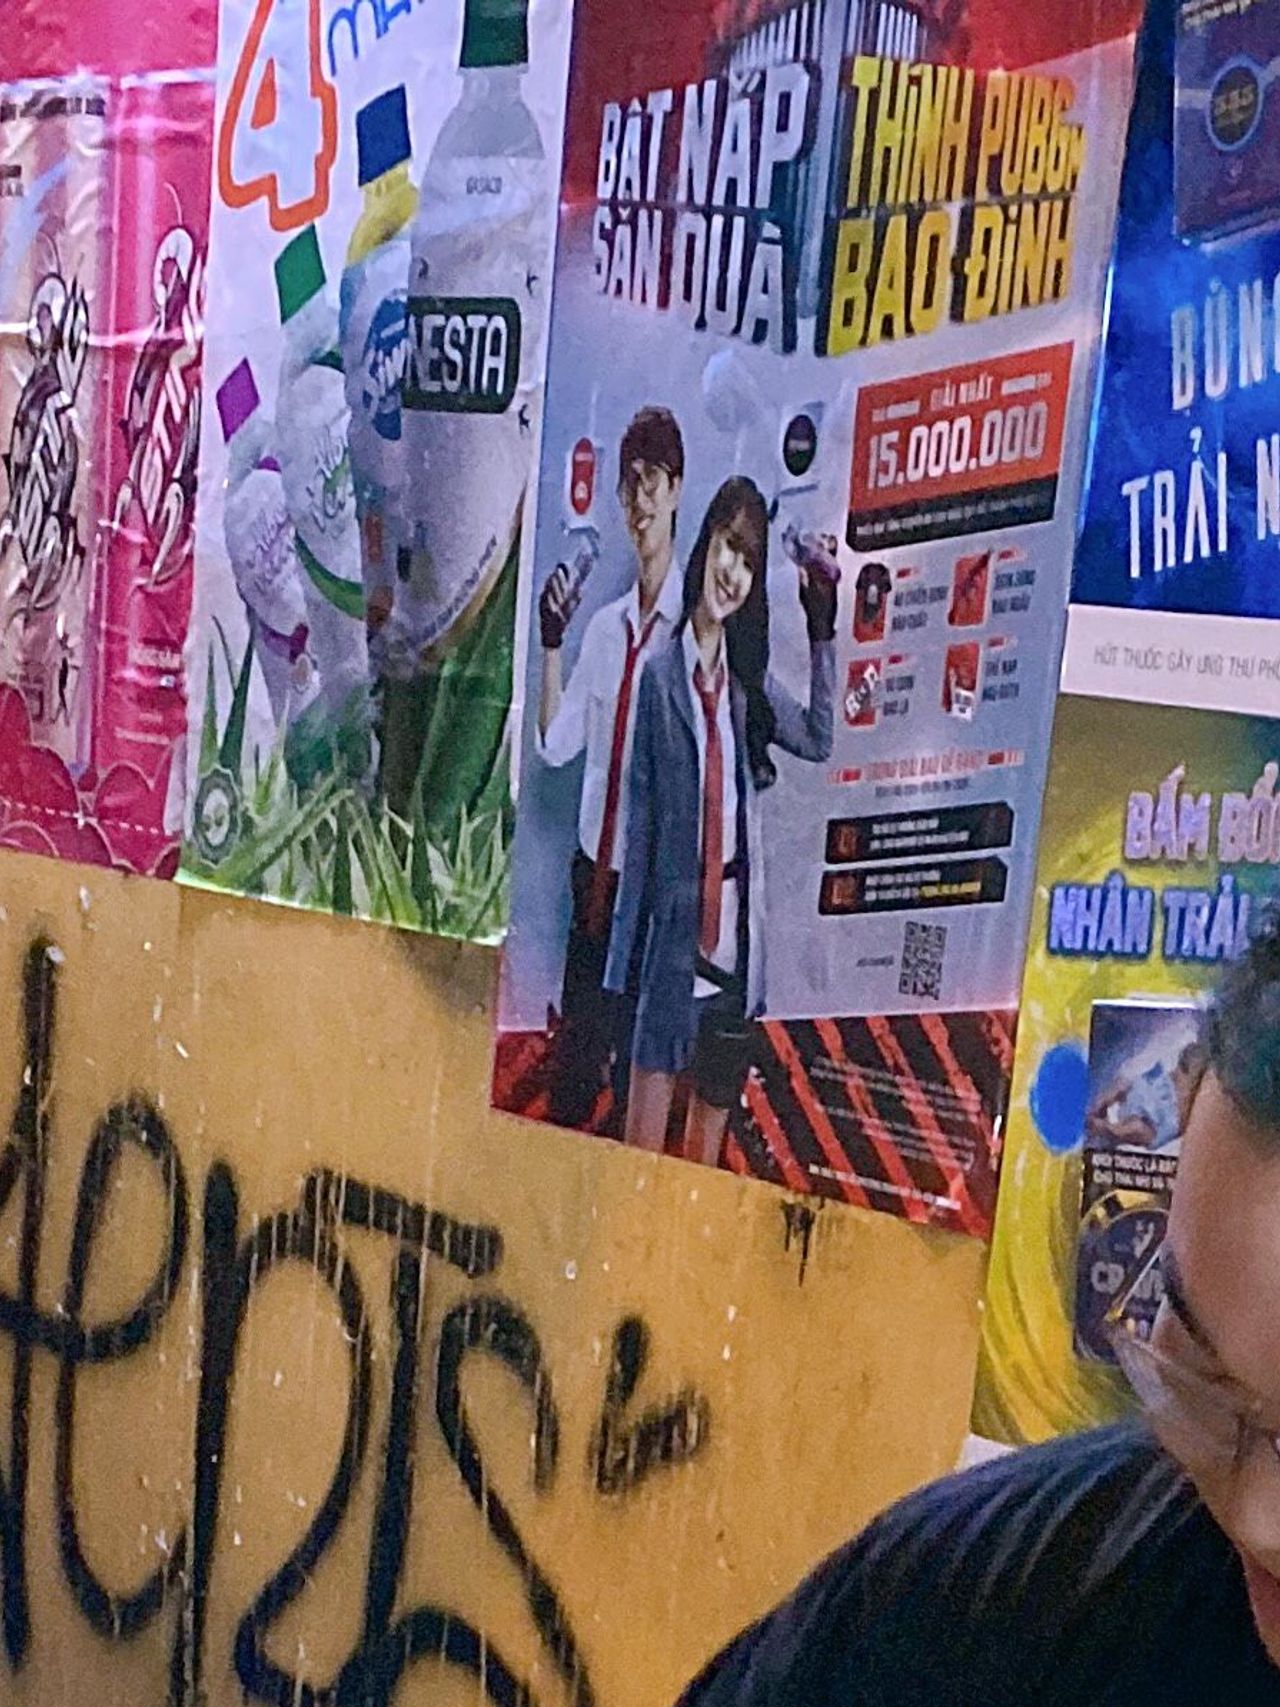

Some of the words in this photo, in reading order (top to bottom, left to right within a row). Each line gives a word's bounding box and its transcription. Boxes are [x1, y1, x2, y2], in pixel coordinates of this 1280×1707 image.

[676, 60, 810, 209] NẮP
[828, 209, 952, 356] BAO
[867, 402, 1049, 490] 15.000.000
[1122, 427, 1228, 579] TRẢI
